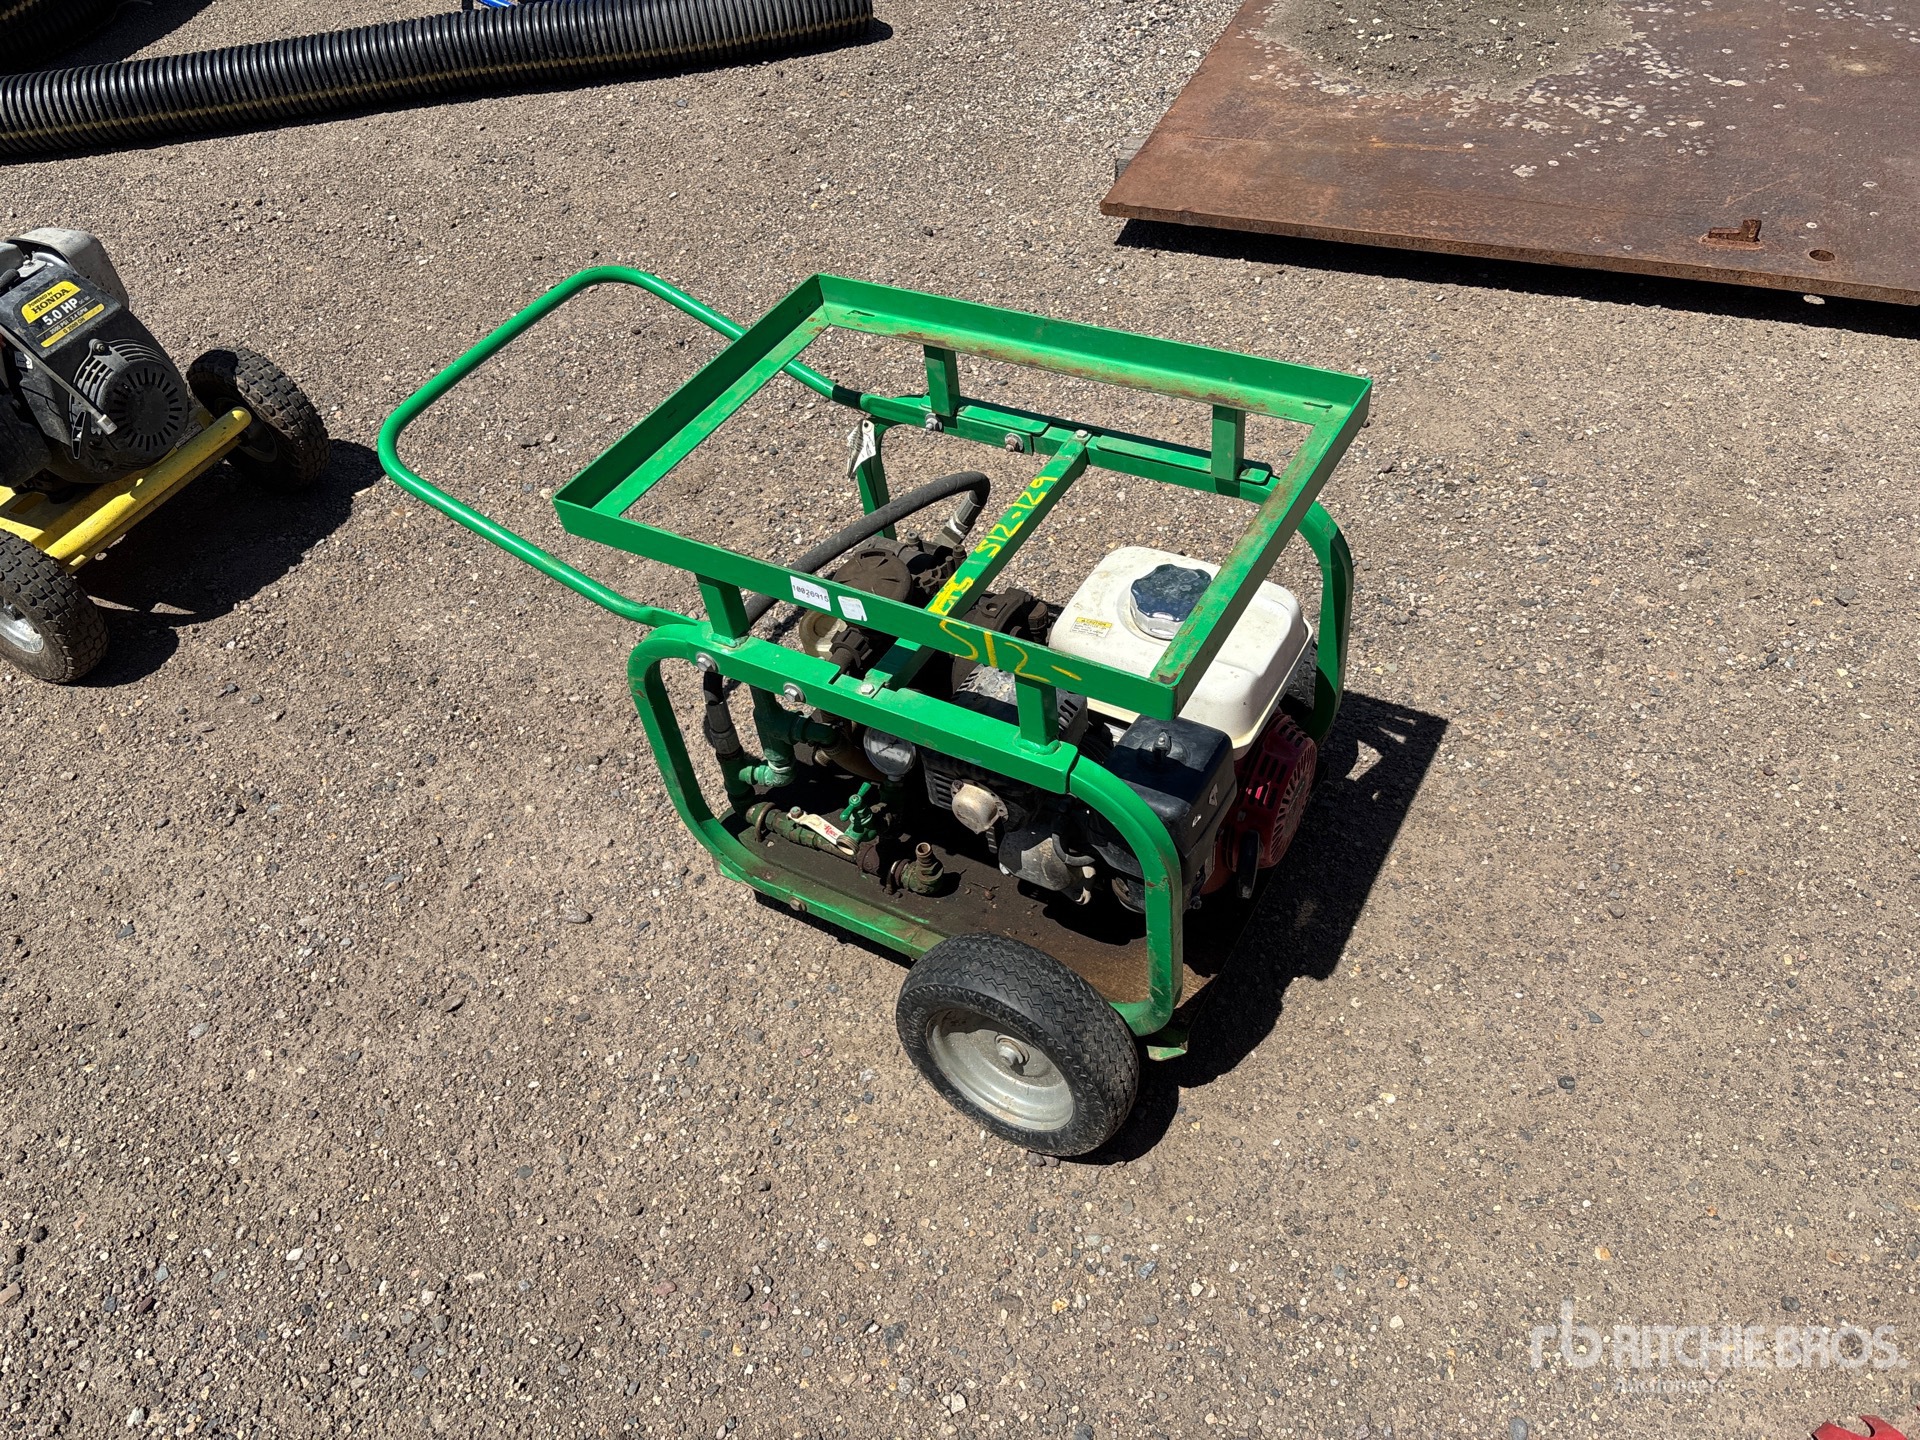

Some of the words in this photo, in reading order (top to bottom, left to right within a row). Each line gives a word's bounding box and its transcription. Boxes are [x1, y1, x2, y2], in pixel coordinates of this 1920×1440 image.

[31, 288, 70, 314] HONDA
[42, 309, 63, 325] 5.0
[60, 297, 78, 314] HP
[60, 320, 69, 328] PSI
